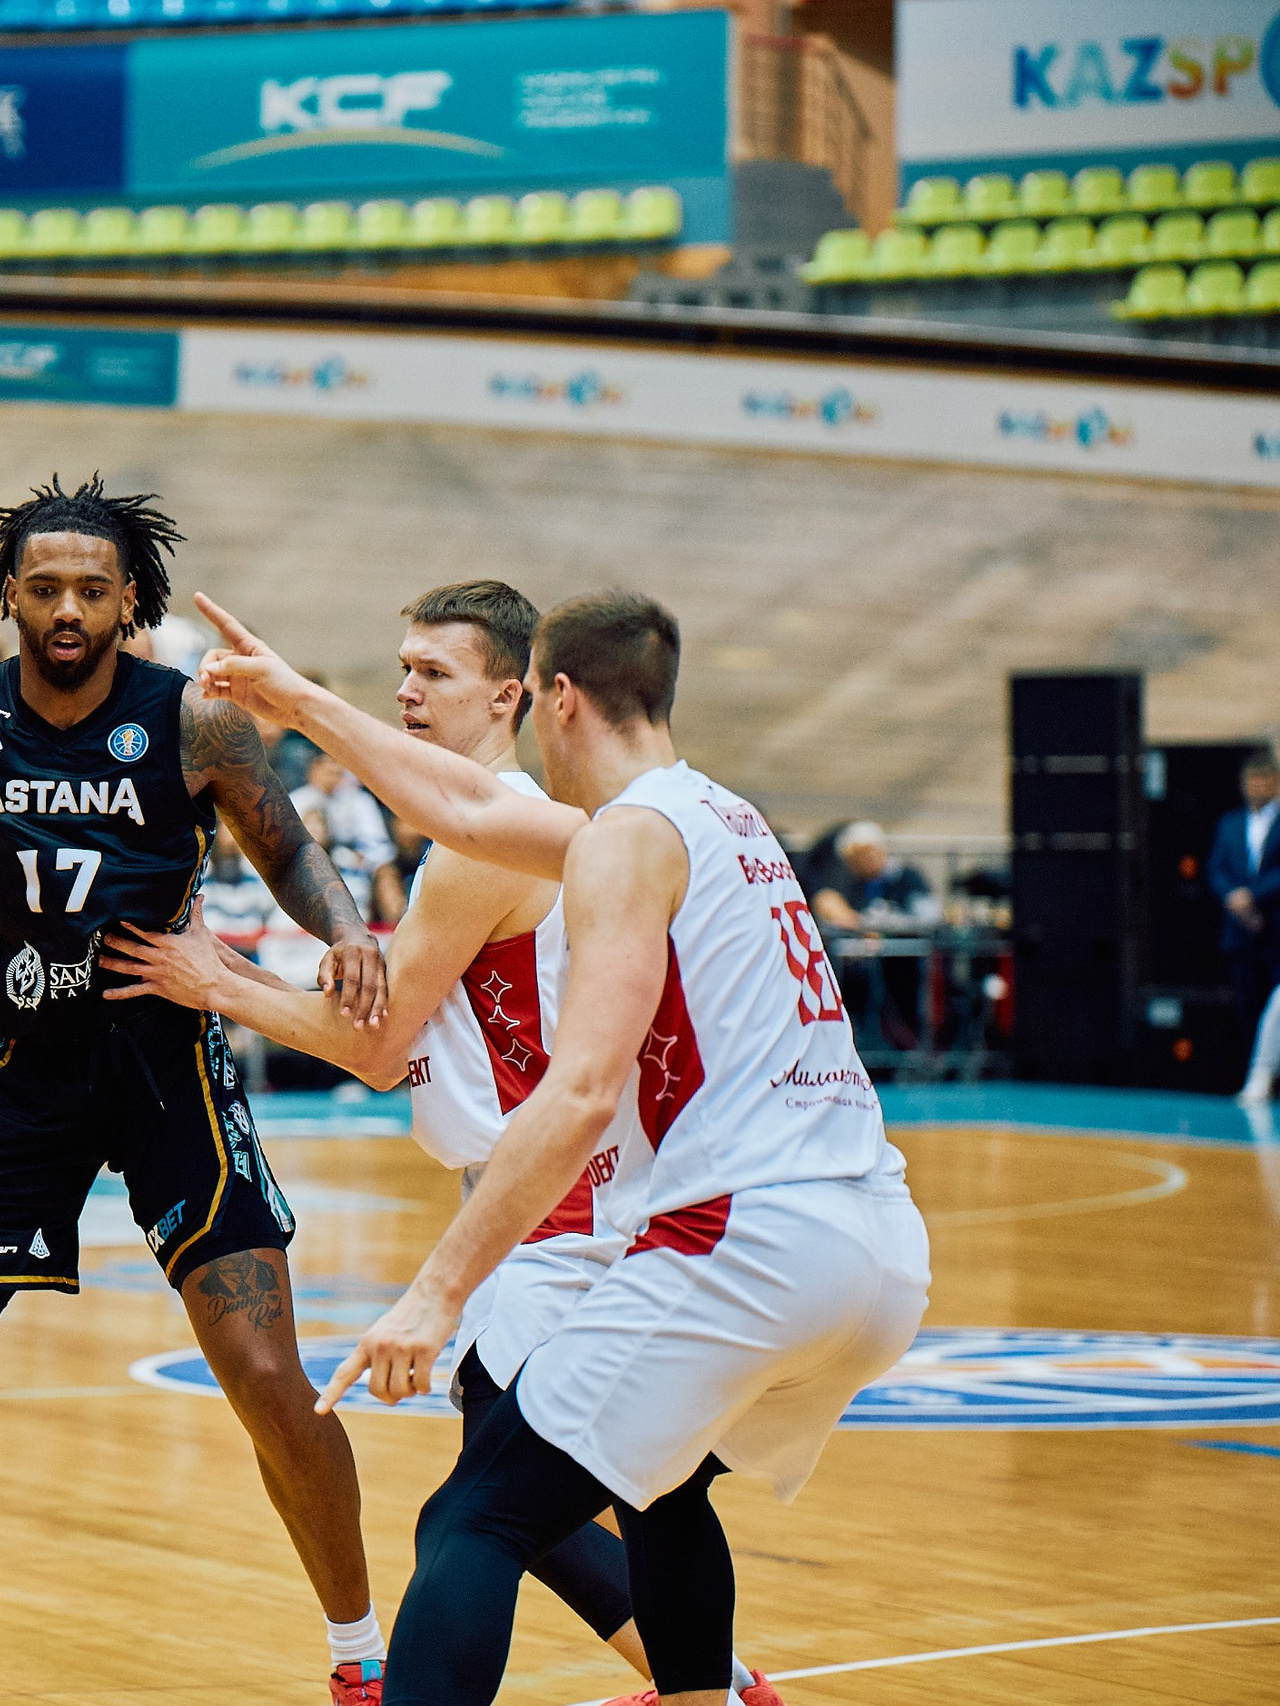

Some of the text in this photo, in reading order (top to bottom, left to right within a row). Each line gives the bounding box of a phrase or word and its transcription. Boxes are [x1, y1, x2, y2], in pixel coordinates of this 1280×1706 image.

[260, 70, 452, 134] KCF
[1013, 32, 1280, 110] KAZSP
[16, 848, 102, 914] 17
